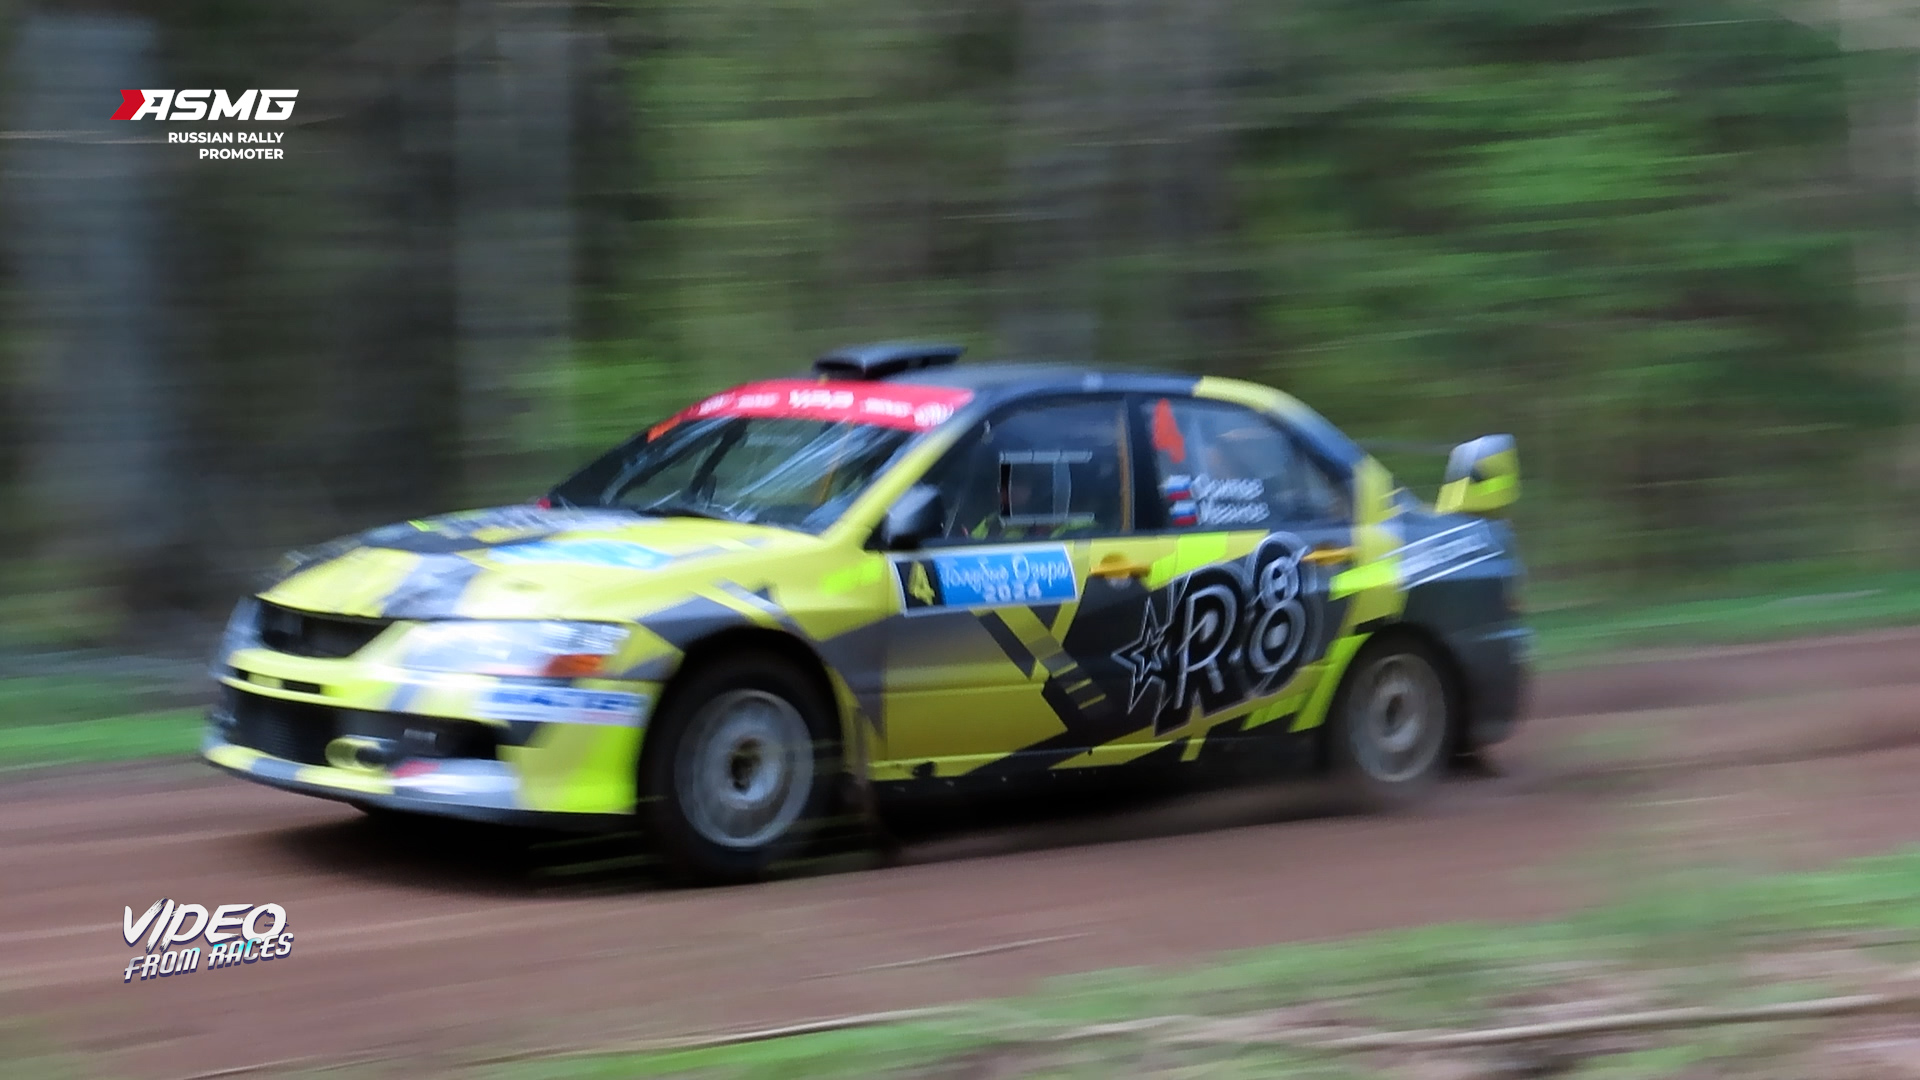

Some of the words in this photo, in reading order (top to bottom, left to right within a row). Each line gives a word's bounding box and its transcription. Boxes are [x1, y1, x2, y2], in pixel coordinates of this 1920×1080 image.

[1152, 398, 1186, 463] 4
[907, 561, 935, 605] 4
[985, 581, 1042, 603] 2024
